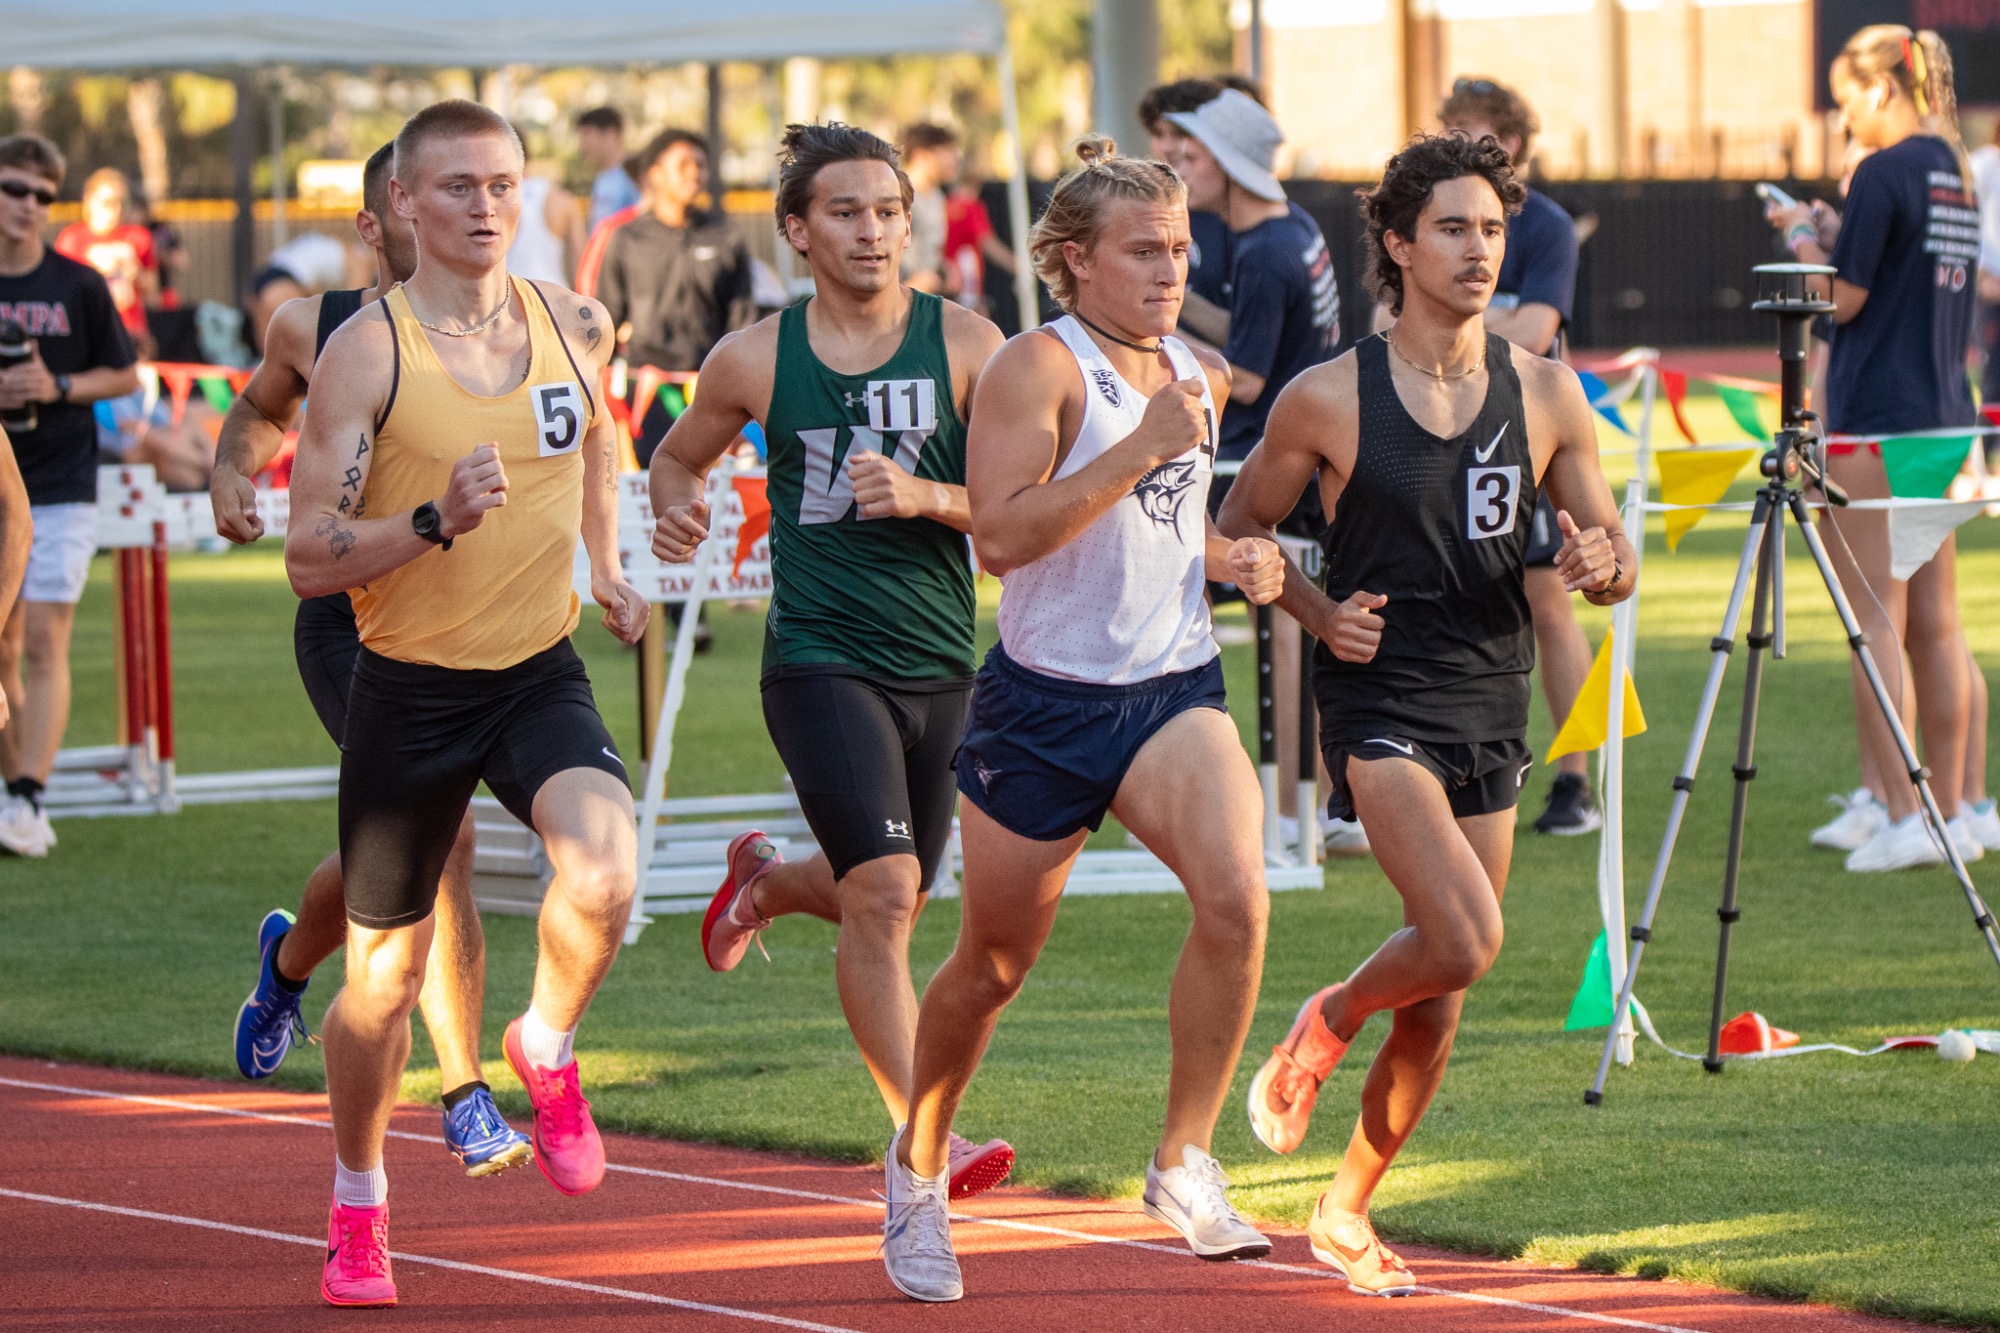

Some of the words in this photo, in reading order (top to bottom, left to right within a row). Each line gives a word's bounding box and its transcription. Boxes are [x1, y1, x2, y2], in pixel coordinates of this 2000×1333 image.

[540, 386, 577, 449] 5
[873, 382, 919, 428] 11
[1475, 472, 1510, 533] 3
